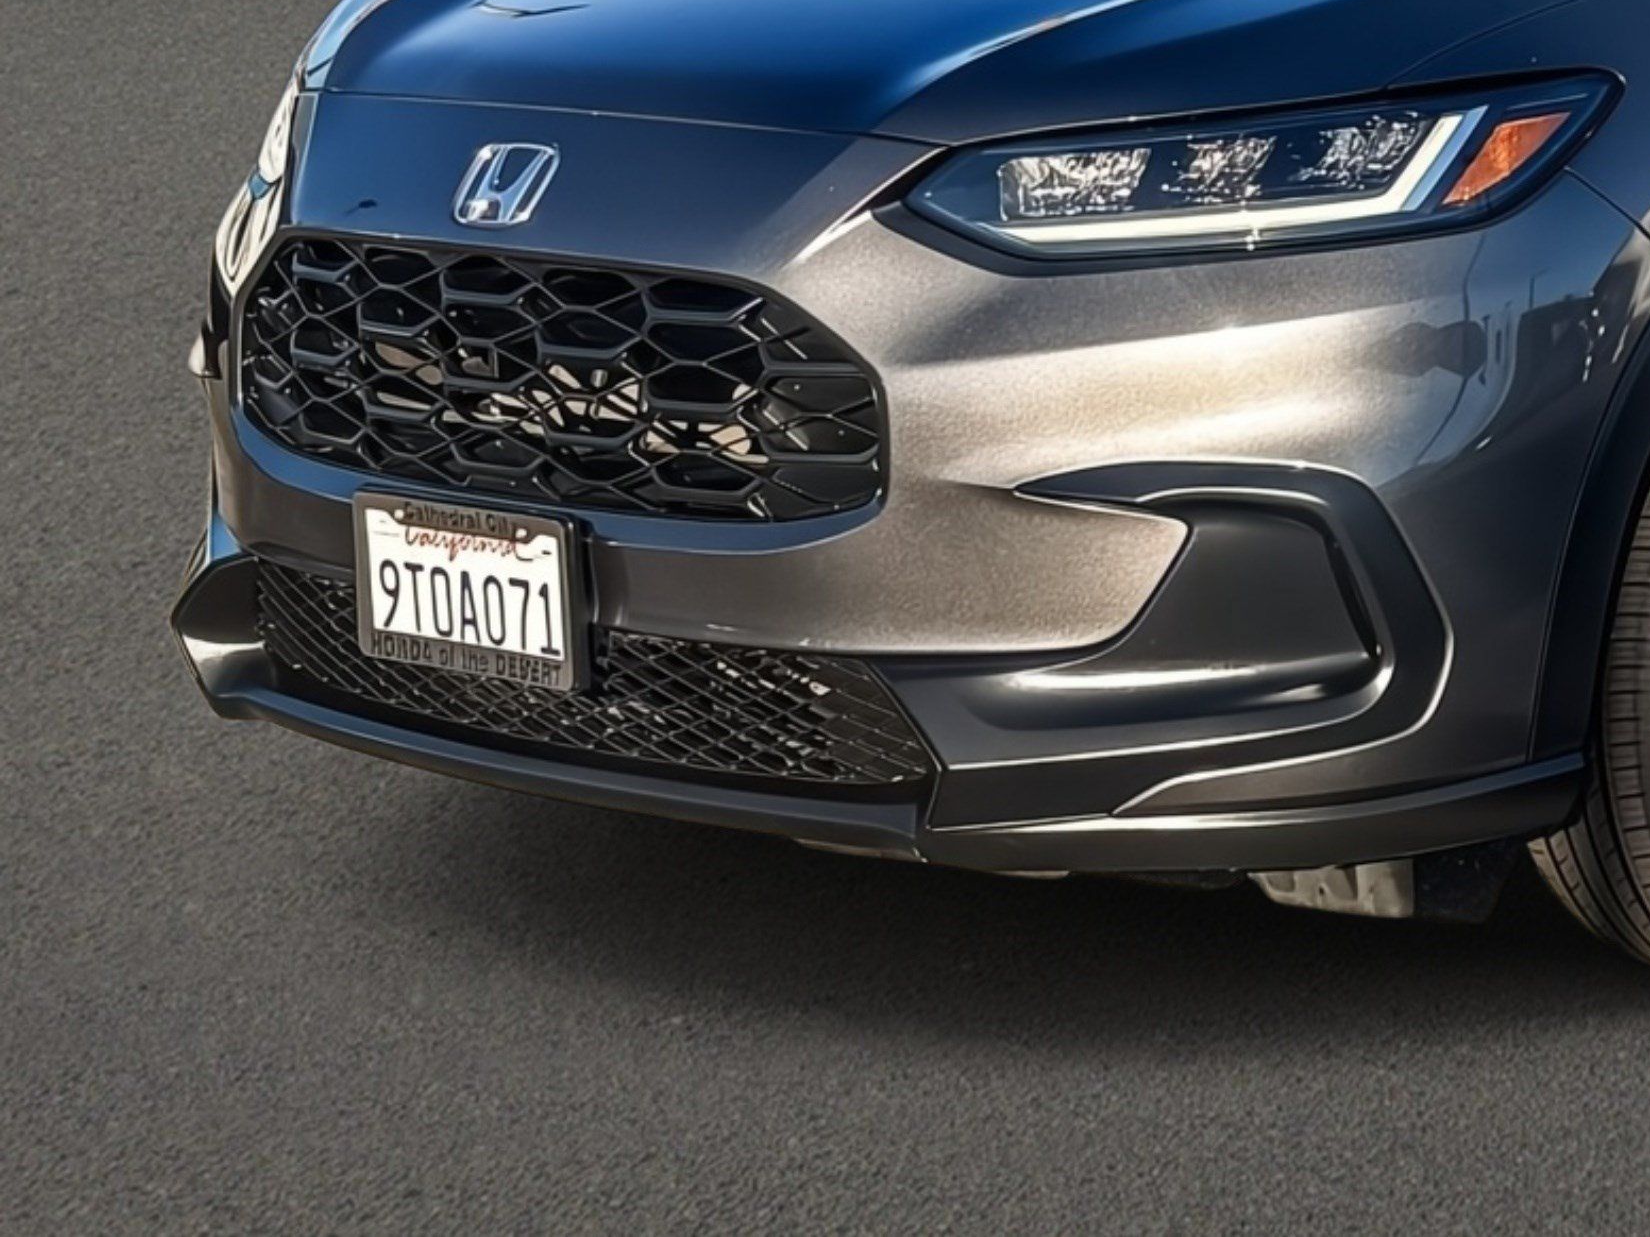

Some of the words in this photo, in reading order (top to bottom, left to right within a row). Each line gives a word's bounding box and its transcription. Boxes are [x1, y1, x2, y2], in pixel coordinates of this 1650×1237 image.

[371, 633, 431, 659] HONDA
[461, 648, 490, 672] the
[495, 654, 562, 686] DESERT
